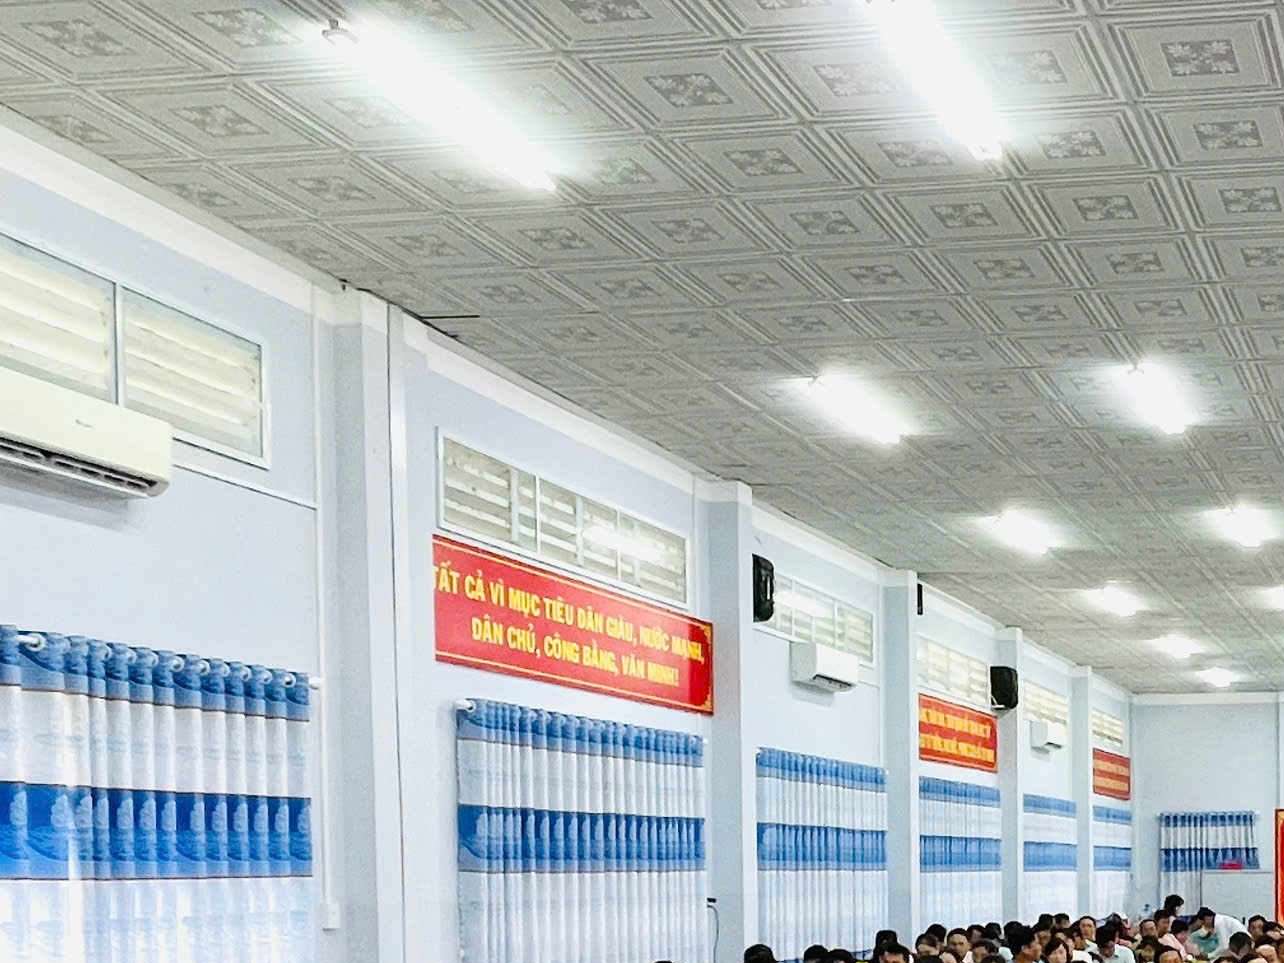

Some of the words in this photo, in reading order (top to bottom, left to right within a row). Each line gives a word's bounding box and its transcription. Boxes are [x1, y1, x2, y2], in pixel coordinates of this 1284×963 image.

[465, 569, 486, 602] CẢ
[489, 578, 504, 607] VÌ
[509, 587, 540, 618] MỤC
[543, 592, 574, 625] TIÊU
[471, 615, 503, 645] DÂN
[507, 623, 540, 659] CHỦ,
[544, 633, 579, 664] CÔNG
